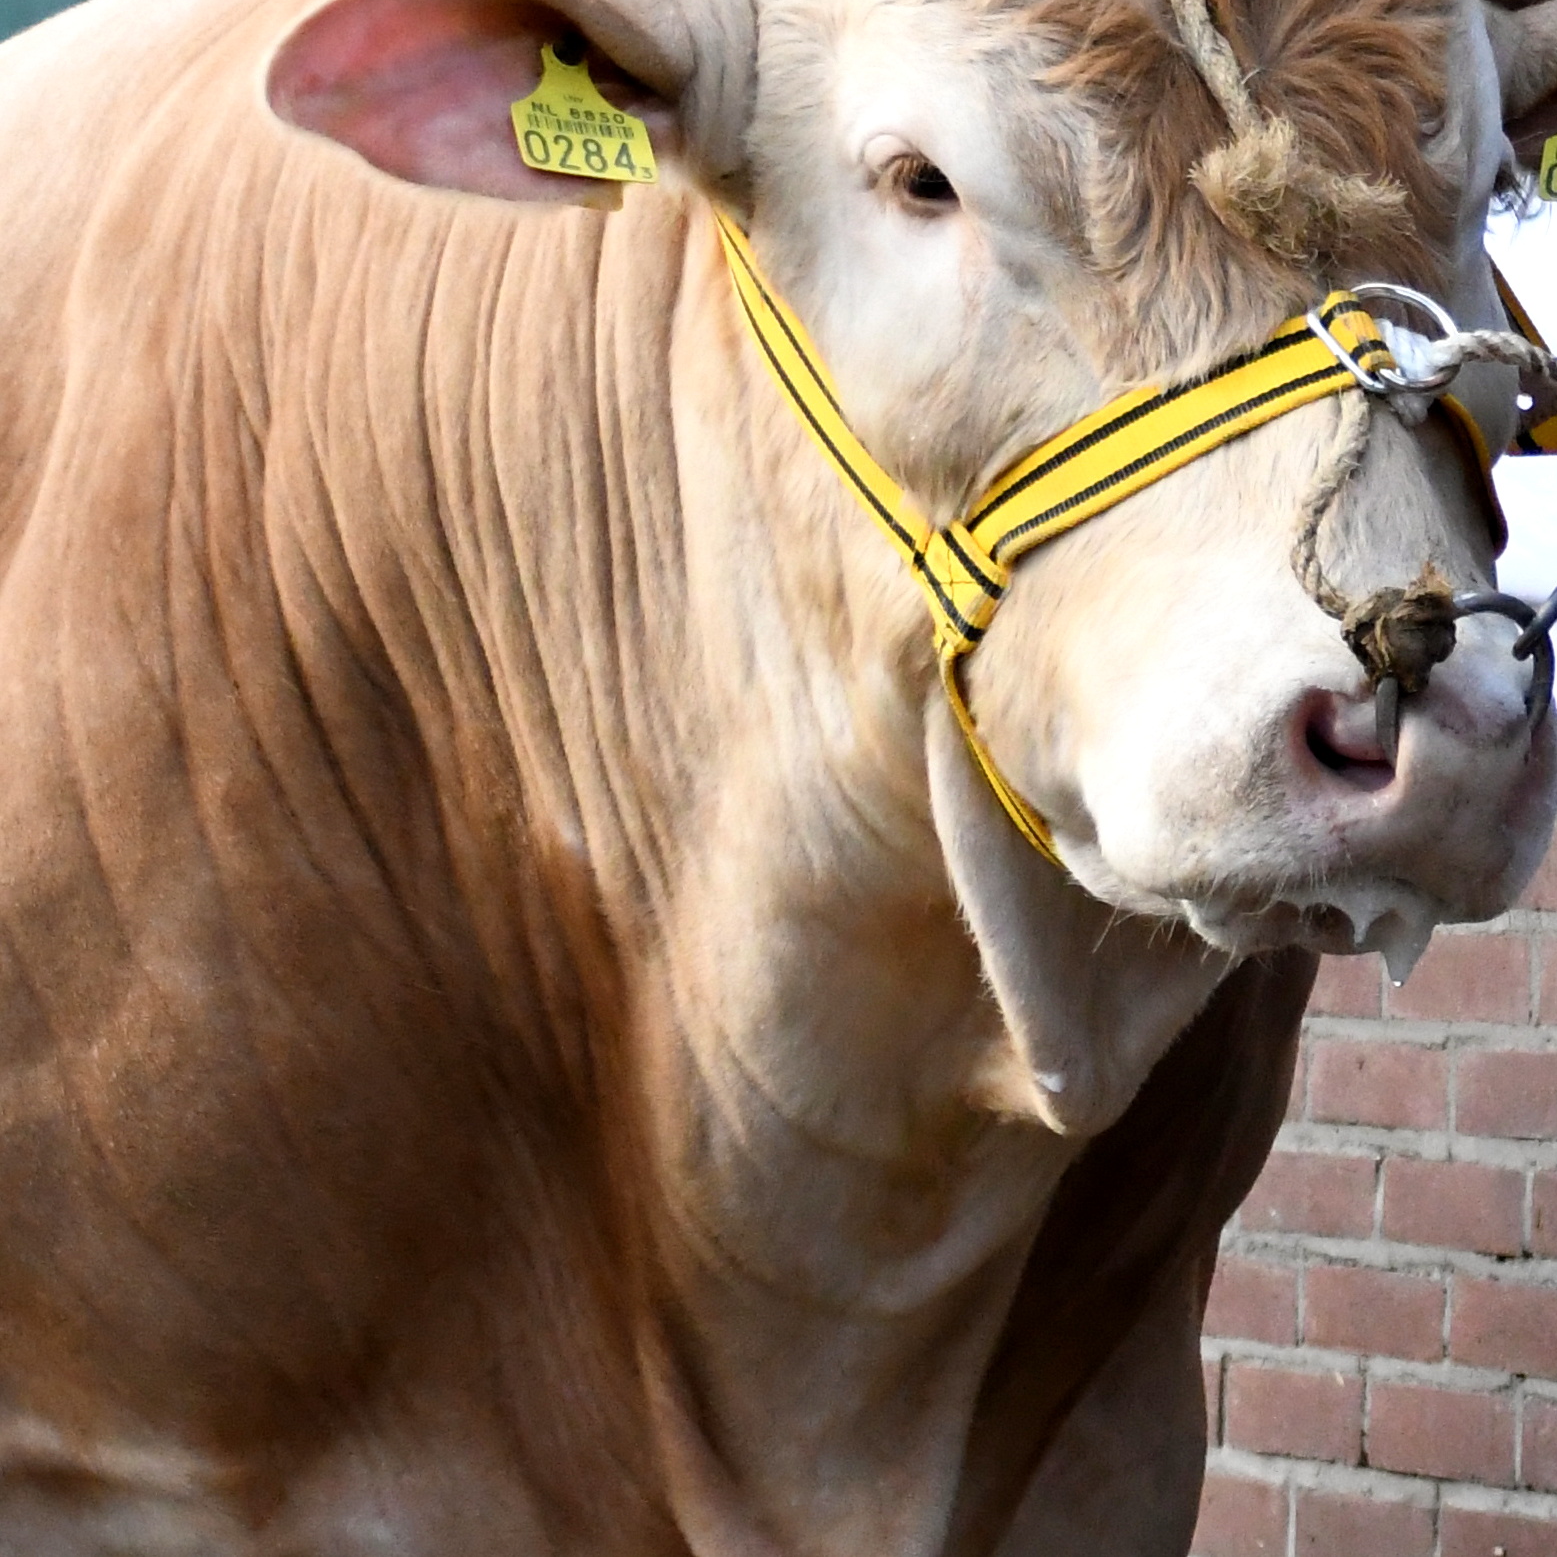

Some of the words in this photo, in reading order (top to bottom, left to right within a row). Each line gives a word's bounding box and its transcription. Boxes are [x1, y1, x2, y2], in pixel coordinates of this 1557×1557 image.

[530, 101, 558, 118] NL
[569, 107, 626, 125] 8850
[523, 129, 637, 177] 0284
